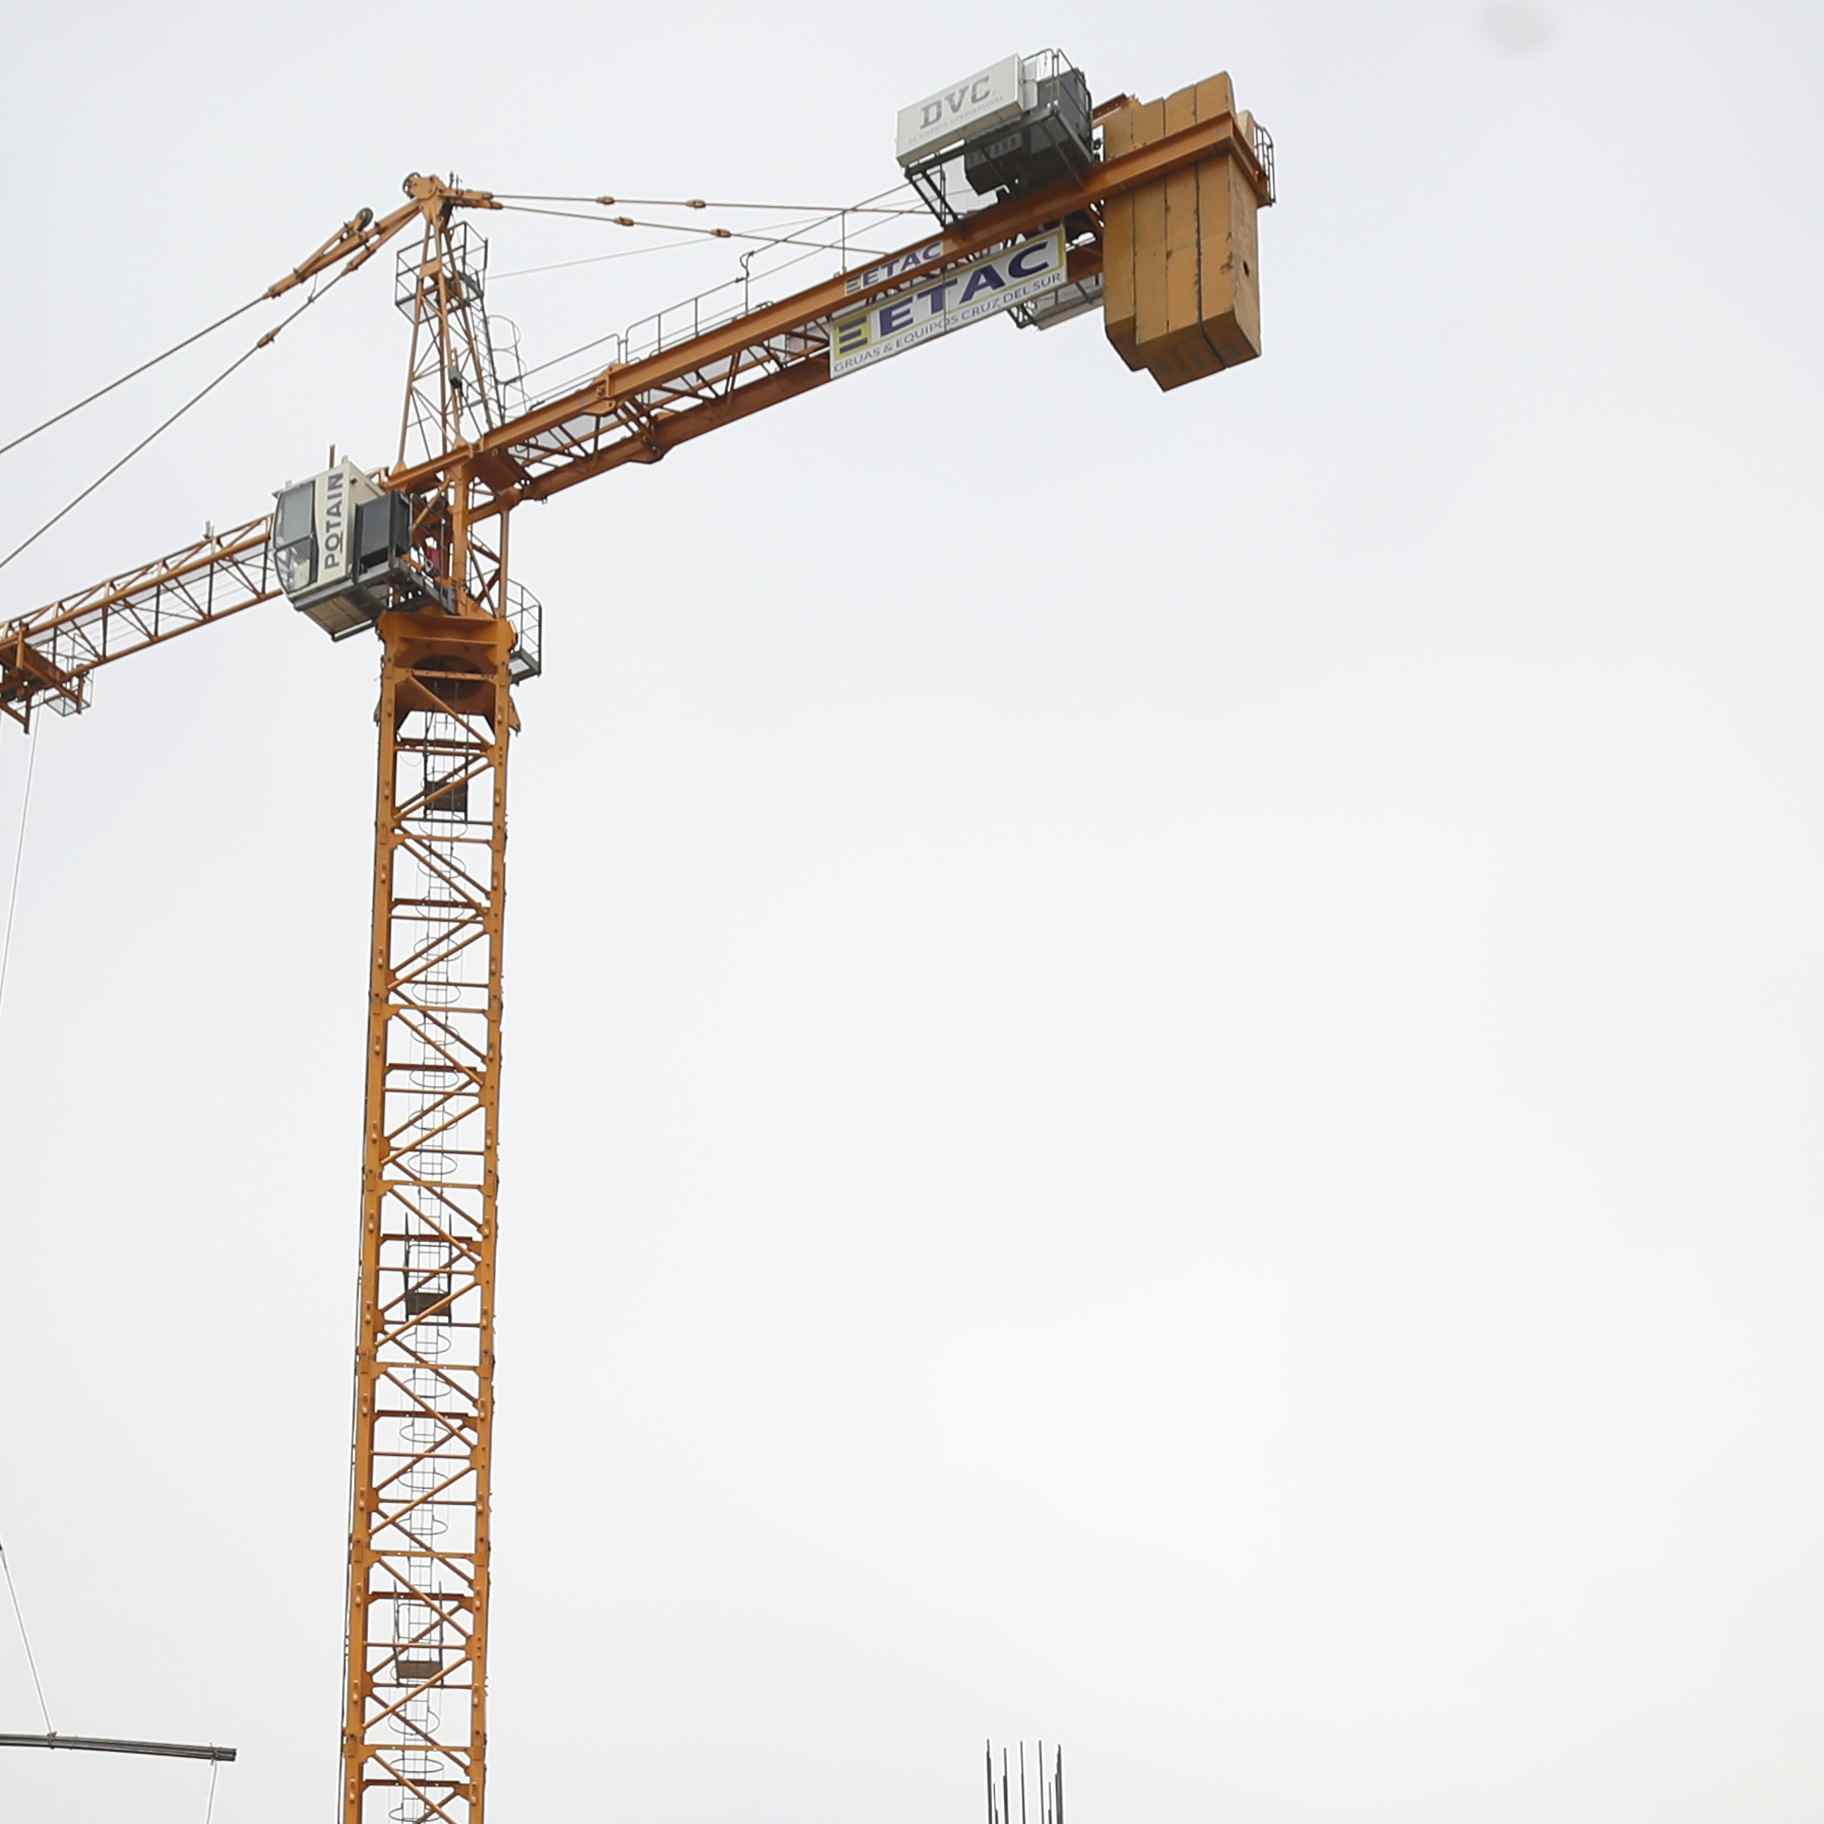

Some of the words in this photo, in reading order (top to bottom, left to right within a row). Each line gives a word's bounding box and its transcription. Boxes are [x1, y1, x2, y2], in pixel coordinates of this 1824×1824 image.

[920, 75, 990, 129] DVC
[833, 348, 881, 373] GRUAS
[896, 315, 958, 348] EQUIPOS
[961, 300, 1000, 320] CRUZ
[1003, 288, 1029, 304] DEL
[1033, 273, 1061, 290] SUR
[324, 472, 344, 570] POTAIN
